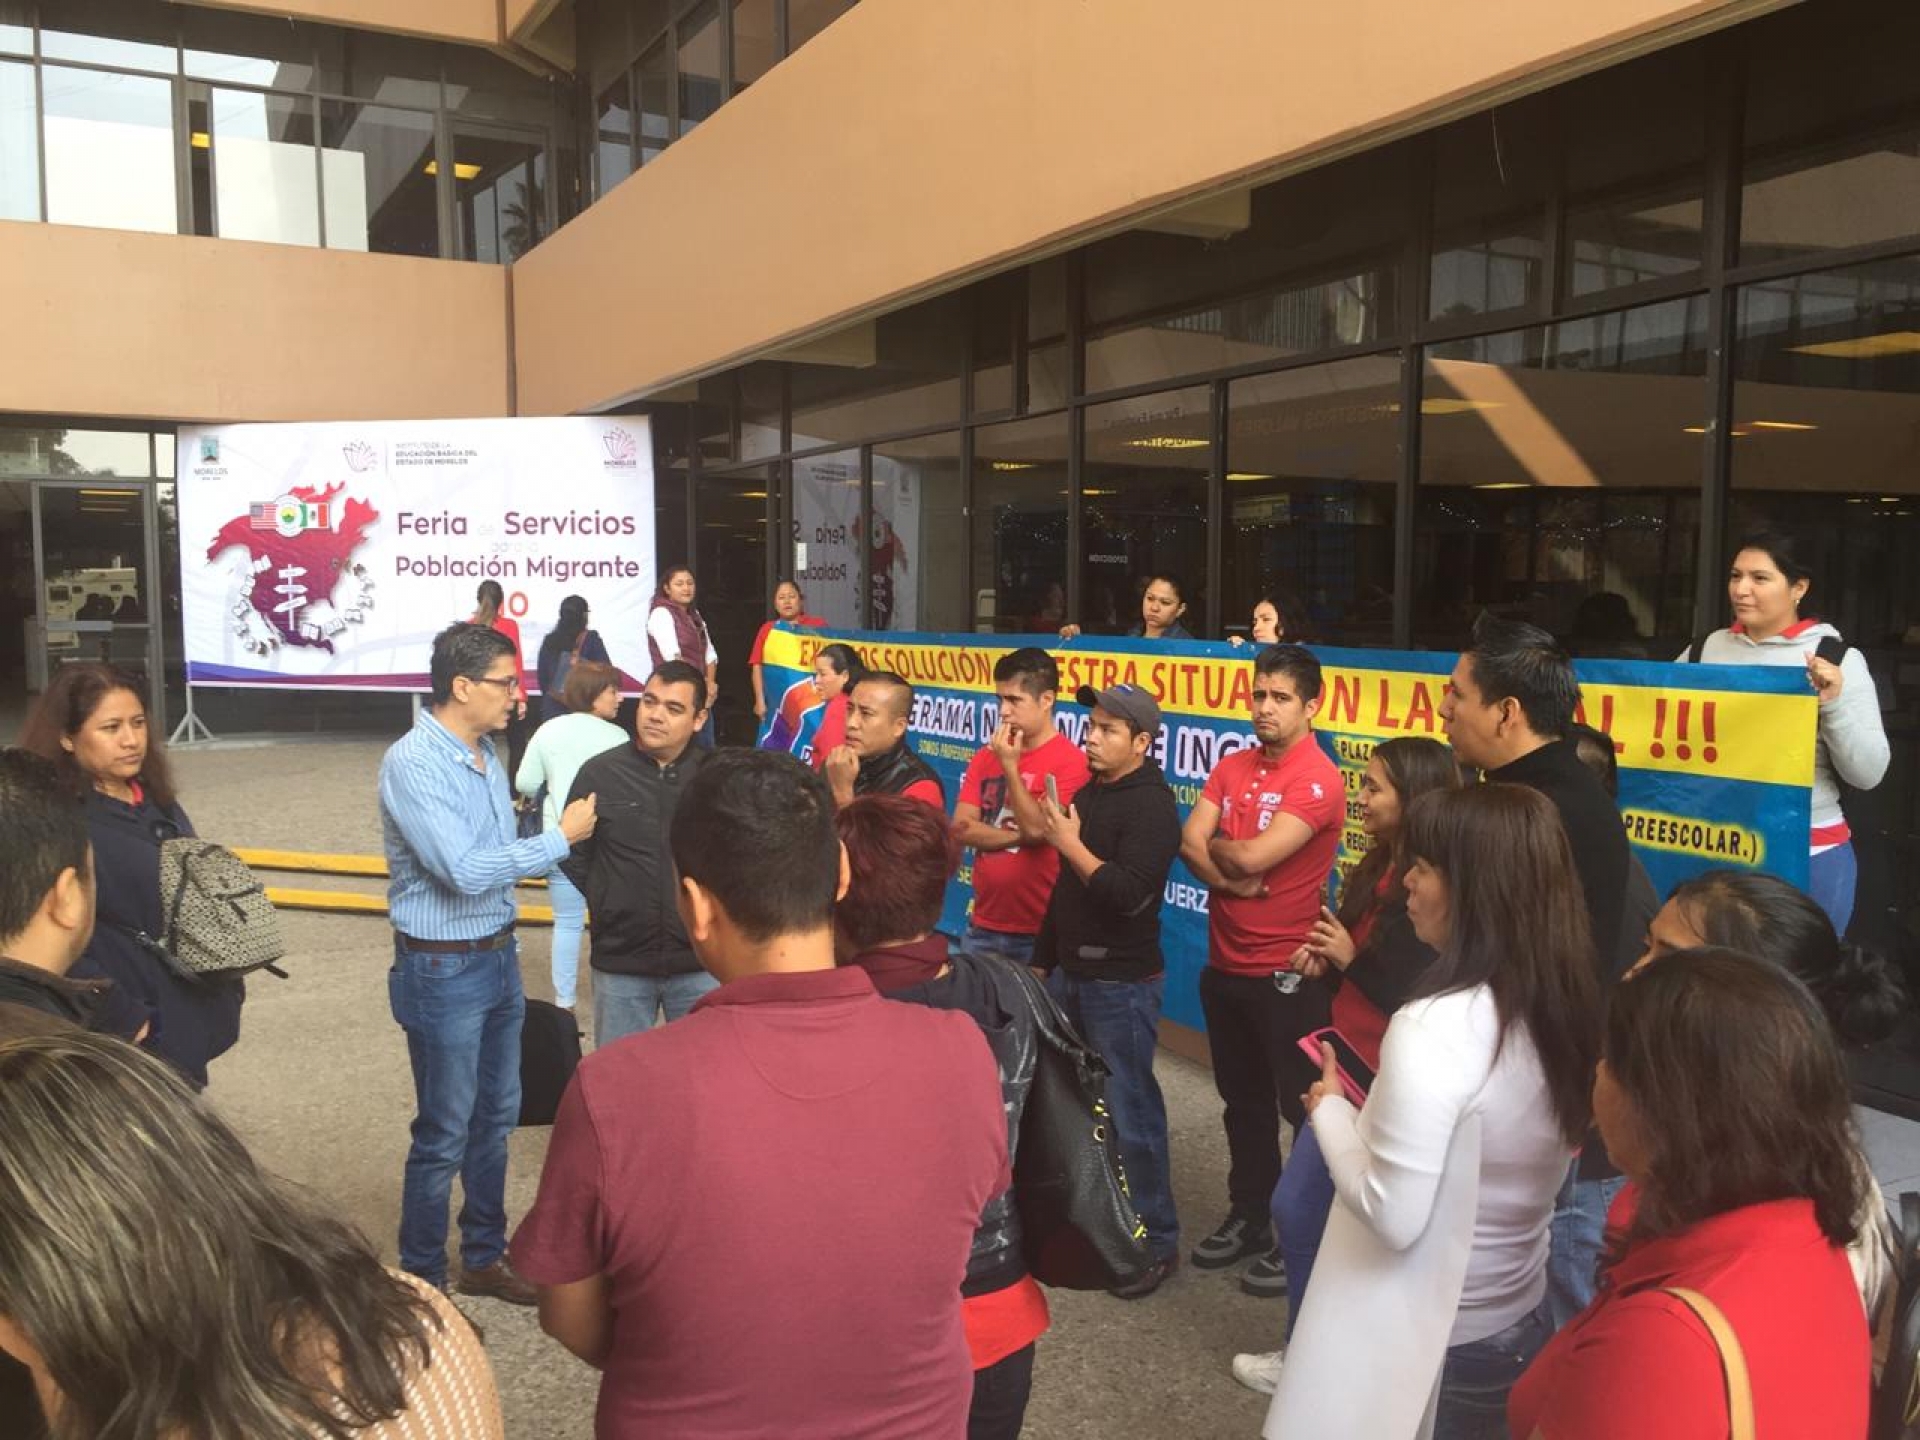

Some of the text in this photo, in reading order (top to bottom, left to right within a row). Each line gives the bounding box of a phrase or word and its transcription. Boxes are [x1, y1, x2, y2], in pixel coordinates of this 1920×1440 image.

[398, 510, 467, 535] Feria
[504, 510, 636, 535] Servicios
[395, 555, 640, 582] Población Migrante
[884, 646, 991, 686] SOLUCIÓN
[1650, 698, 1718, 763] !!!
[1625, 814, 1758, 864] PREESCOLAR.)
